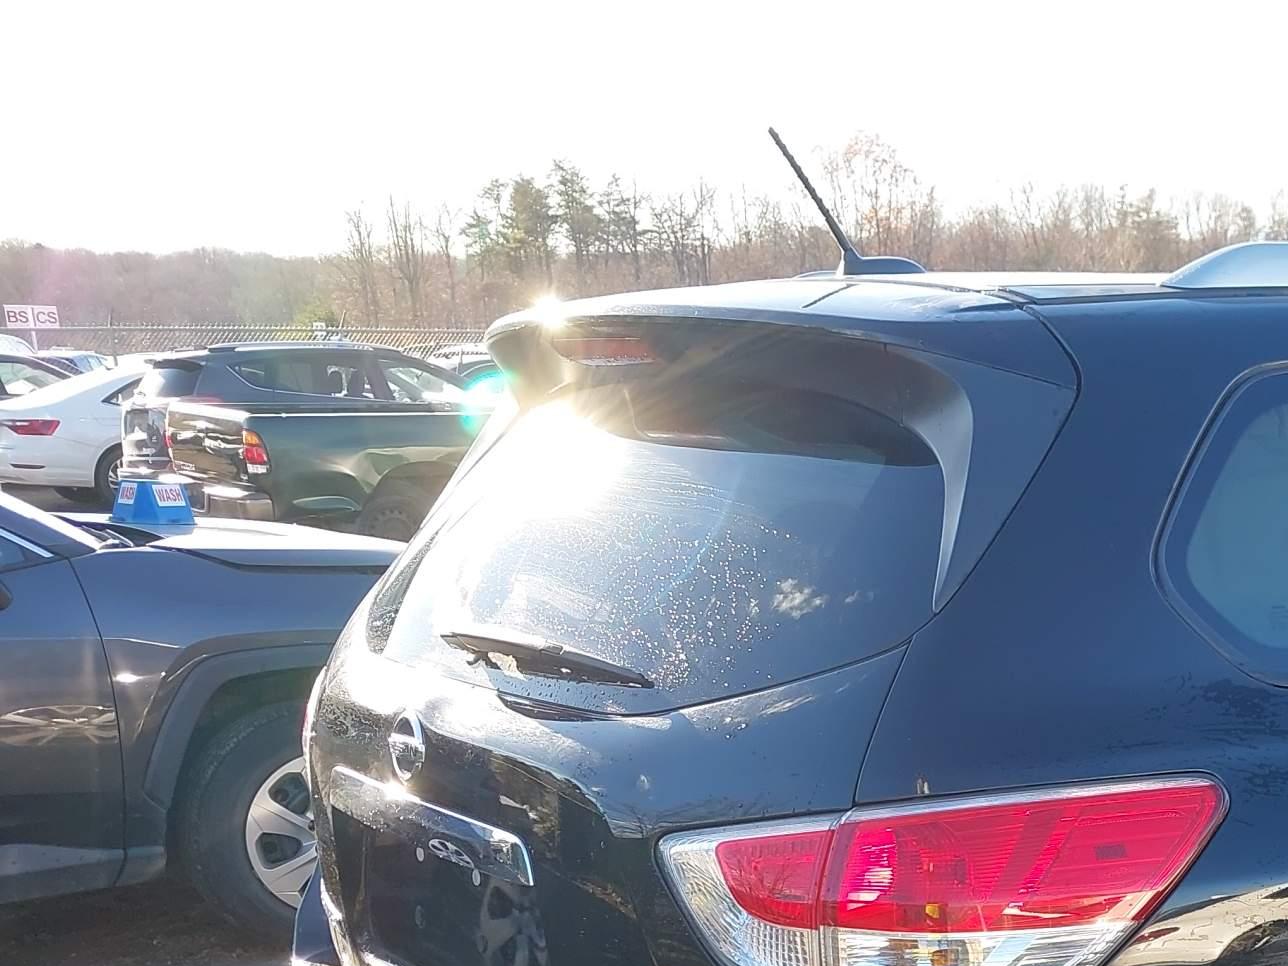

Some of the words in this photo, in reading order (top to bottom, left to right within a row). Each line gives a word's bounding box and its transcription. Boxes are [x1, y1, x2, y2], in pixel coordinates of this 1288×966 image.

[6, 310, 29, 323] BS
[36, 311, 58, 324] CS
[155, 487, 184, 502] WASH
